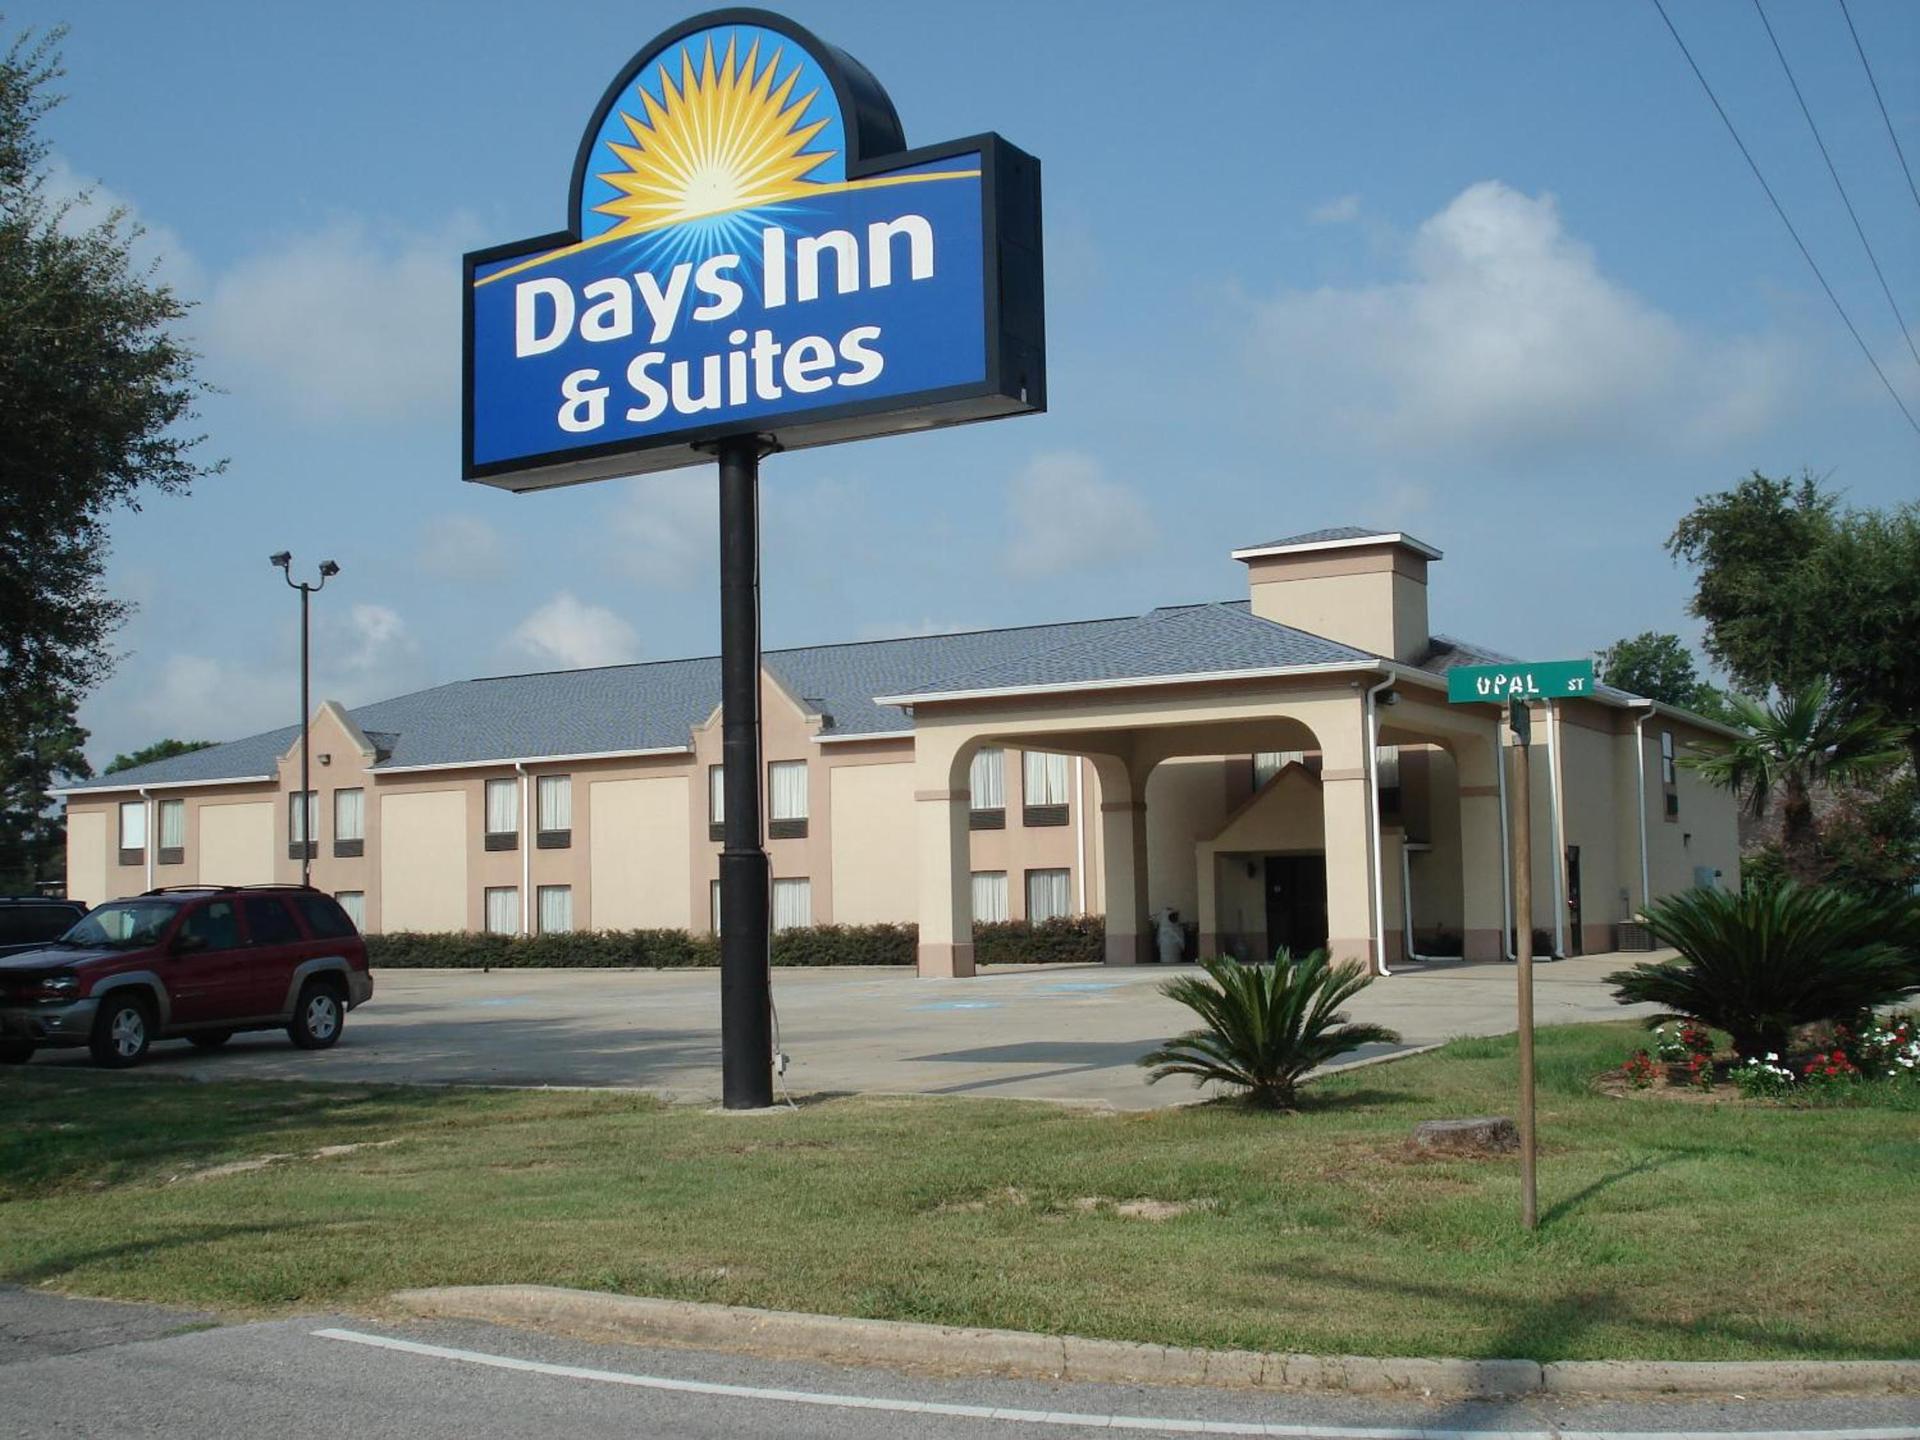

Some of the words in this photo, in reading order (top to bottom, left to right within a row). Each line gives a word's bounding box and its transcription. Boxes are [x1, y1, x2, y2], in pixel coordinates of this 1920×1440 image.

[515, 253, 744, 358] Days
[763, 214, 934, 309] Inn
[557, 368, 610, 433] &
[626, 326, 884, 422] Suites
[1567, 677, 1585, 691] ST
